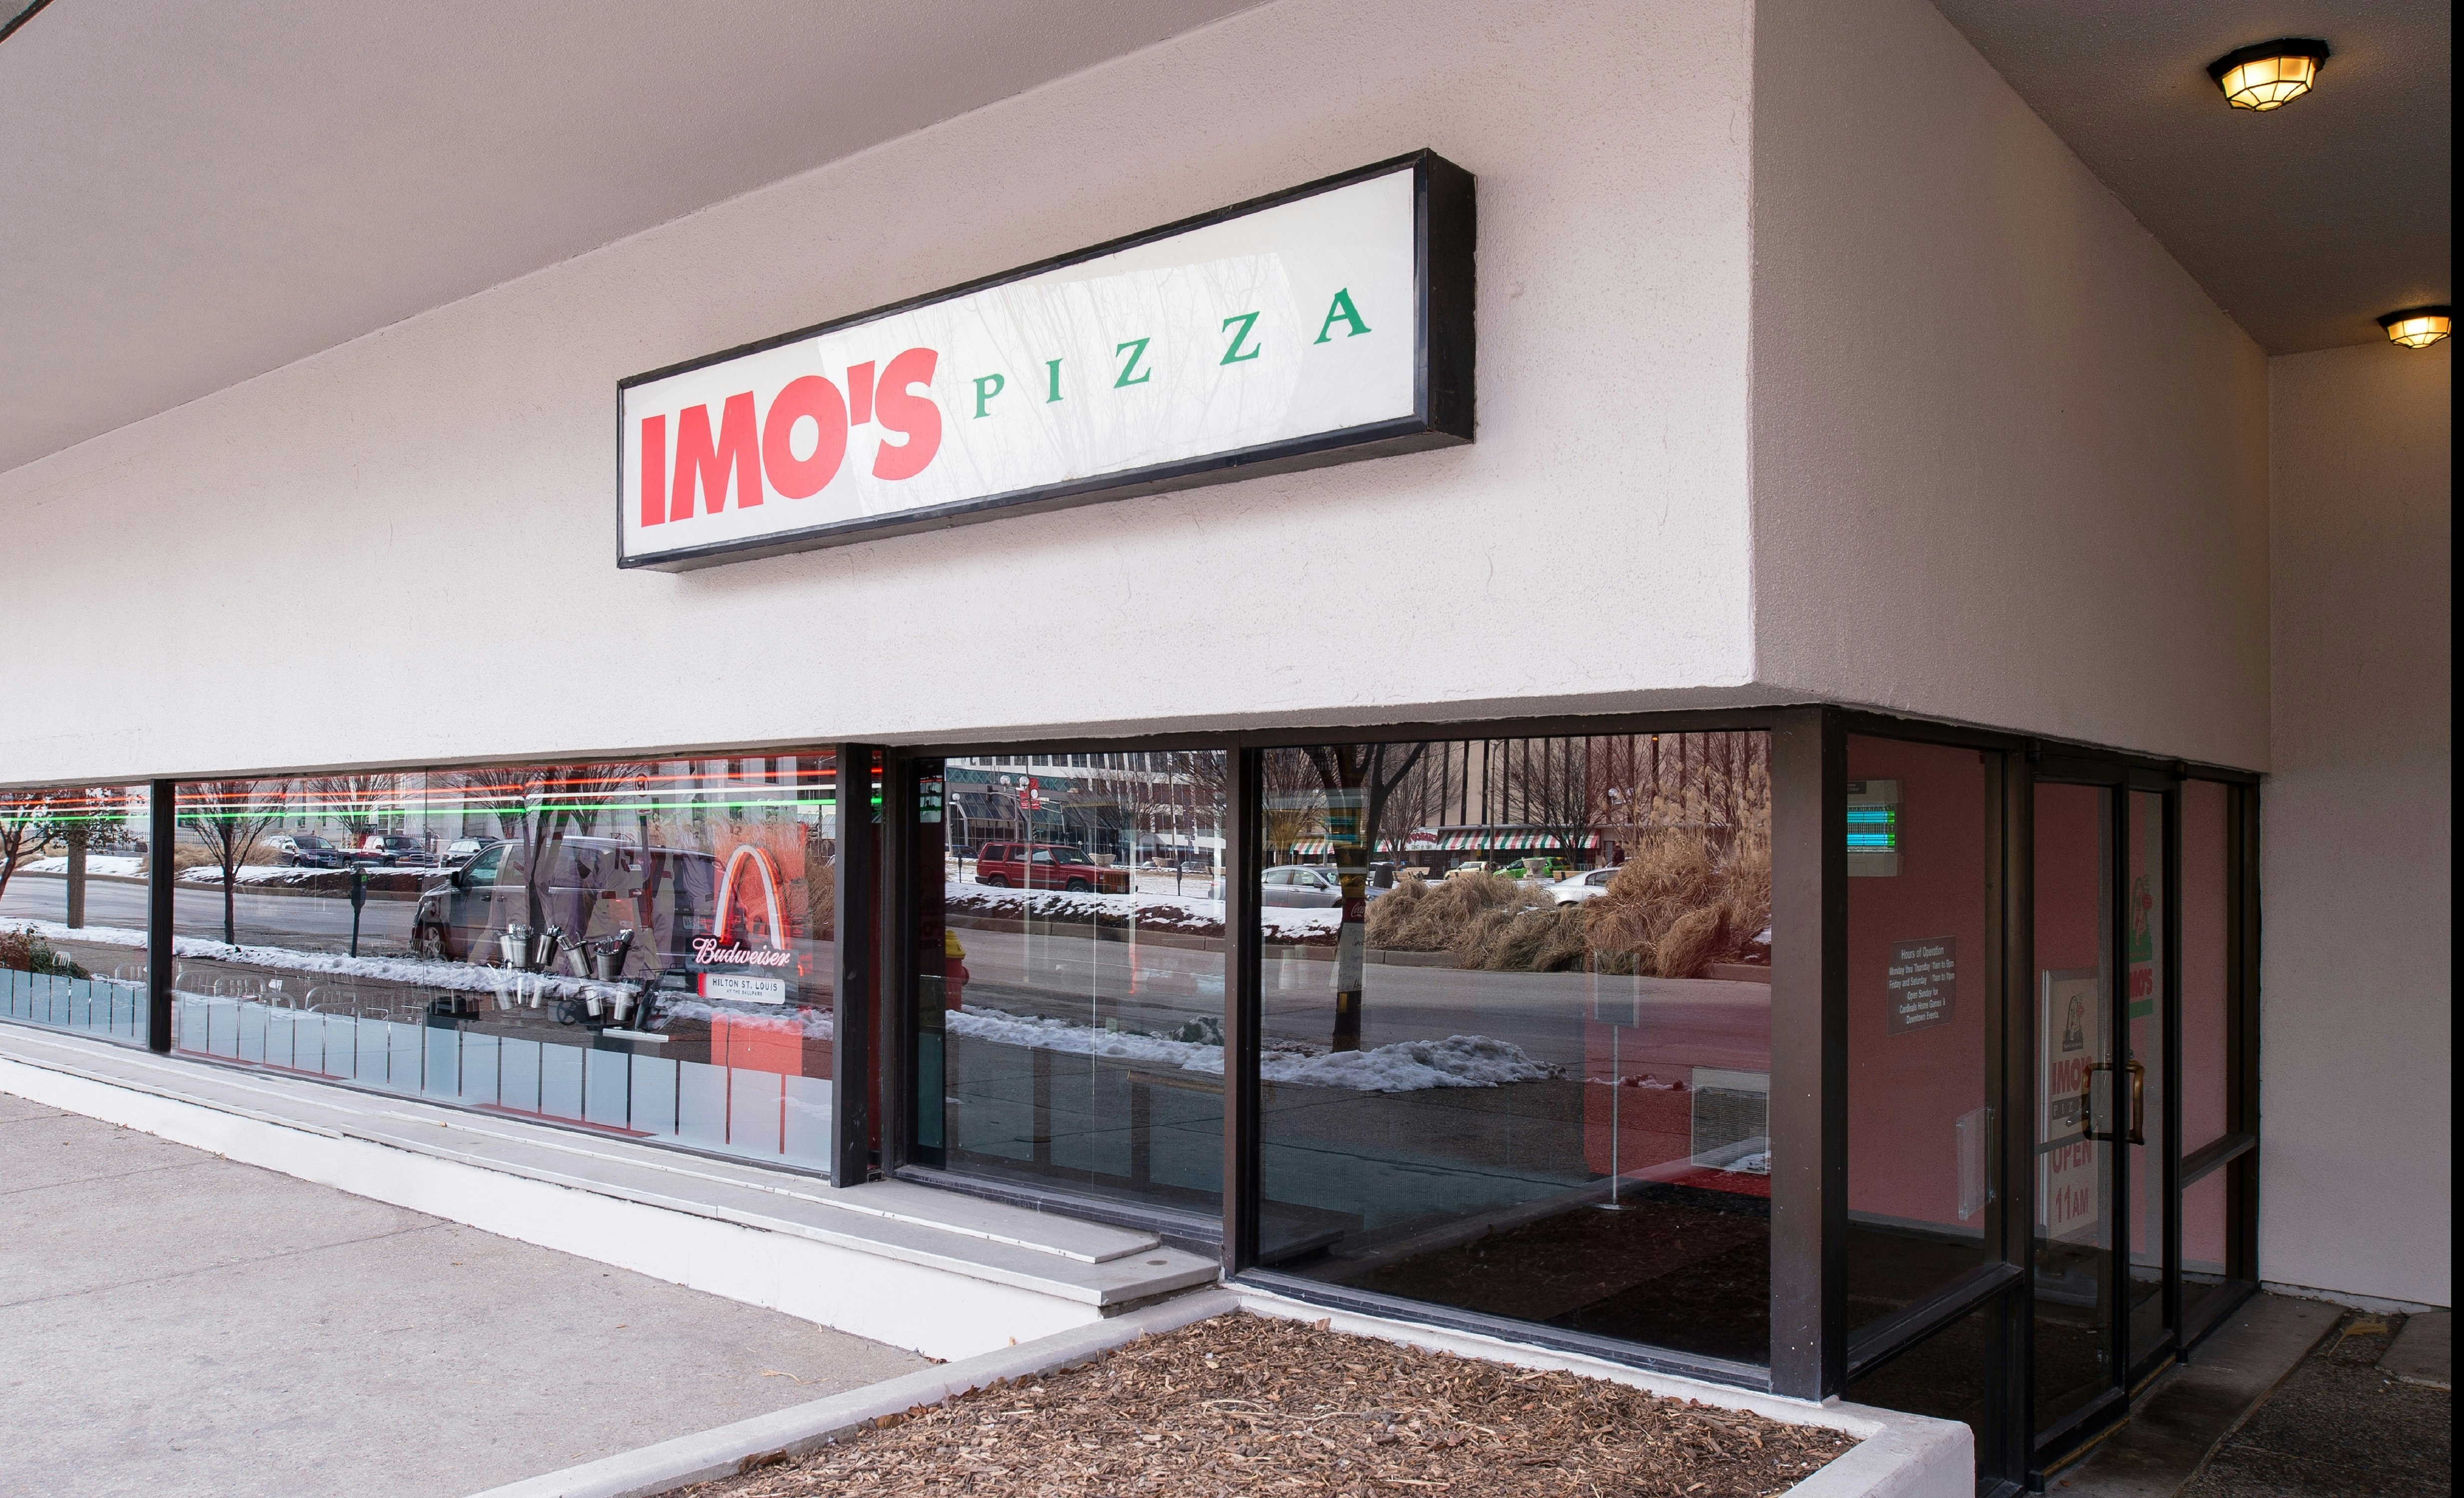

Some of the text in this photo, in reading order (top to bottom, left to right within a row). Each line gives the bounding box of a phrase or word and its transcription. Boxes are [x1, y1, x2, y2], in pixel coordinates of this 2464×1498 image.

[641, 288, 1371, 527] IMO'S PIZZA
[692, 938, 790, 966] Budweiser
[1901, 946, 1944, 959] Hours of Operation
[1889, 967, 1904, 975] Monday
[1914, 962, 1930, 972] Thursday
[712, 978, 778, 991] HILTON ST. LOUIS
[1889, 980, 1901, 989] Friday
[1910, 976, 1927, 985] Saturday
[1946, 972, 1955, 981] 11pm
[2129, 968, 2153, 998] MO'S
[1907, 991, 1917, 1001] Open
[1918, 989, 1932, 998] Sunday
[1900, 1003, 1917, 1014] Cardinals
[1929, 999, 1941, 1008] Games
[1906, 1014, 1925, 1024] Downtown
[2052, 1056, 2092, 1095] IMO'S
[2054, 1099, 2082, 1116] PIZZ
[2052, 1140, 2092, 1173] OPEN
